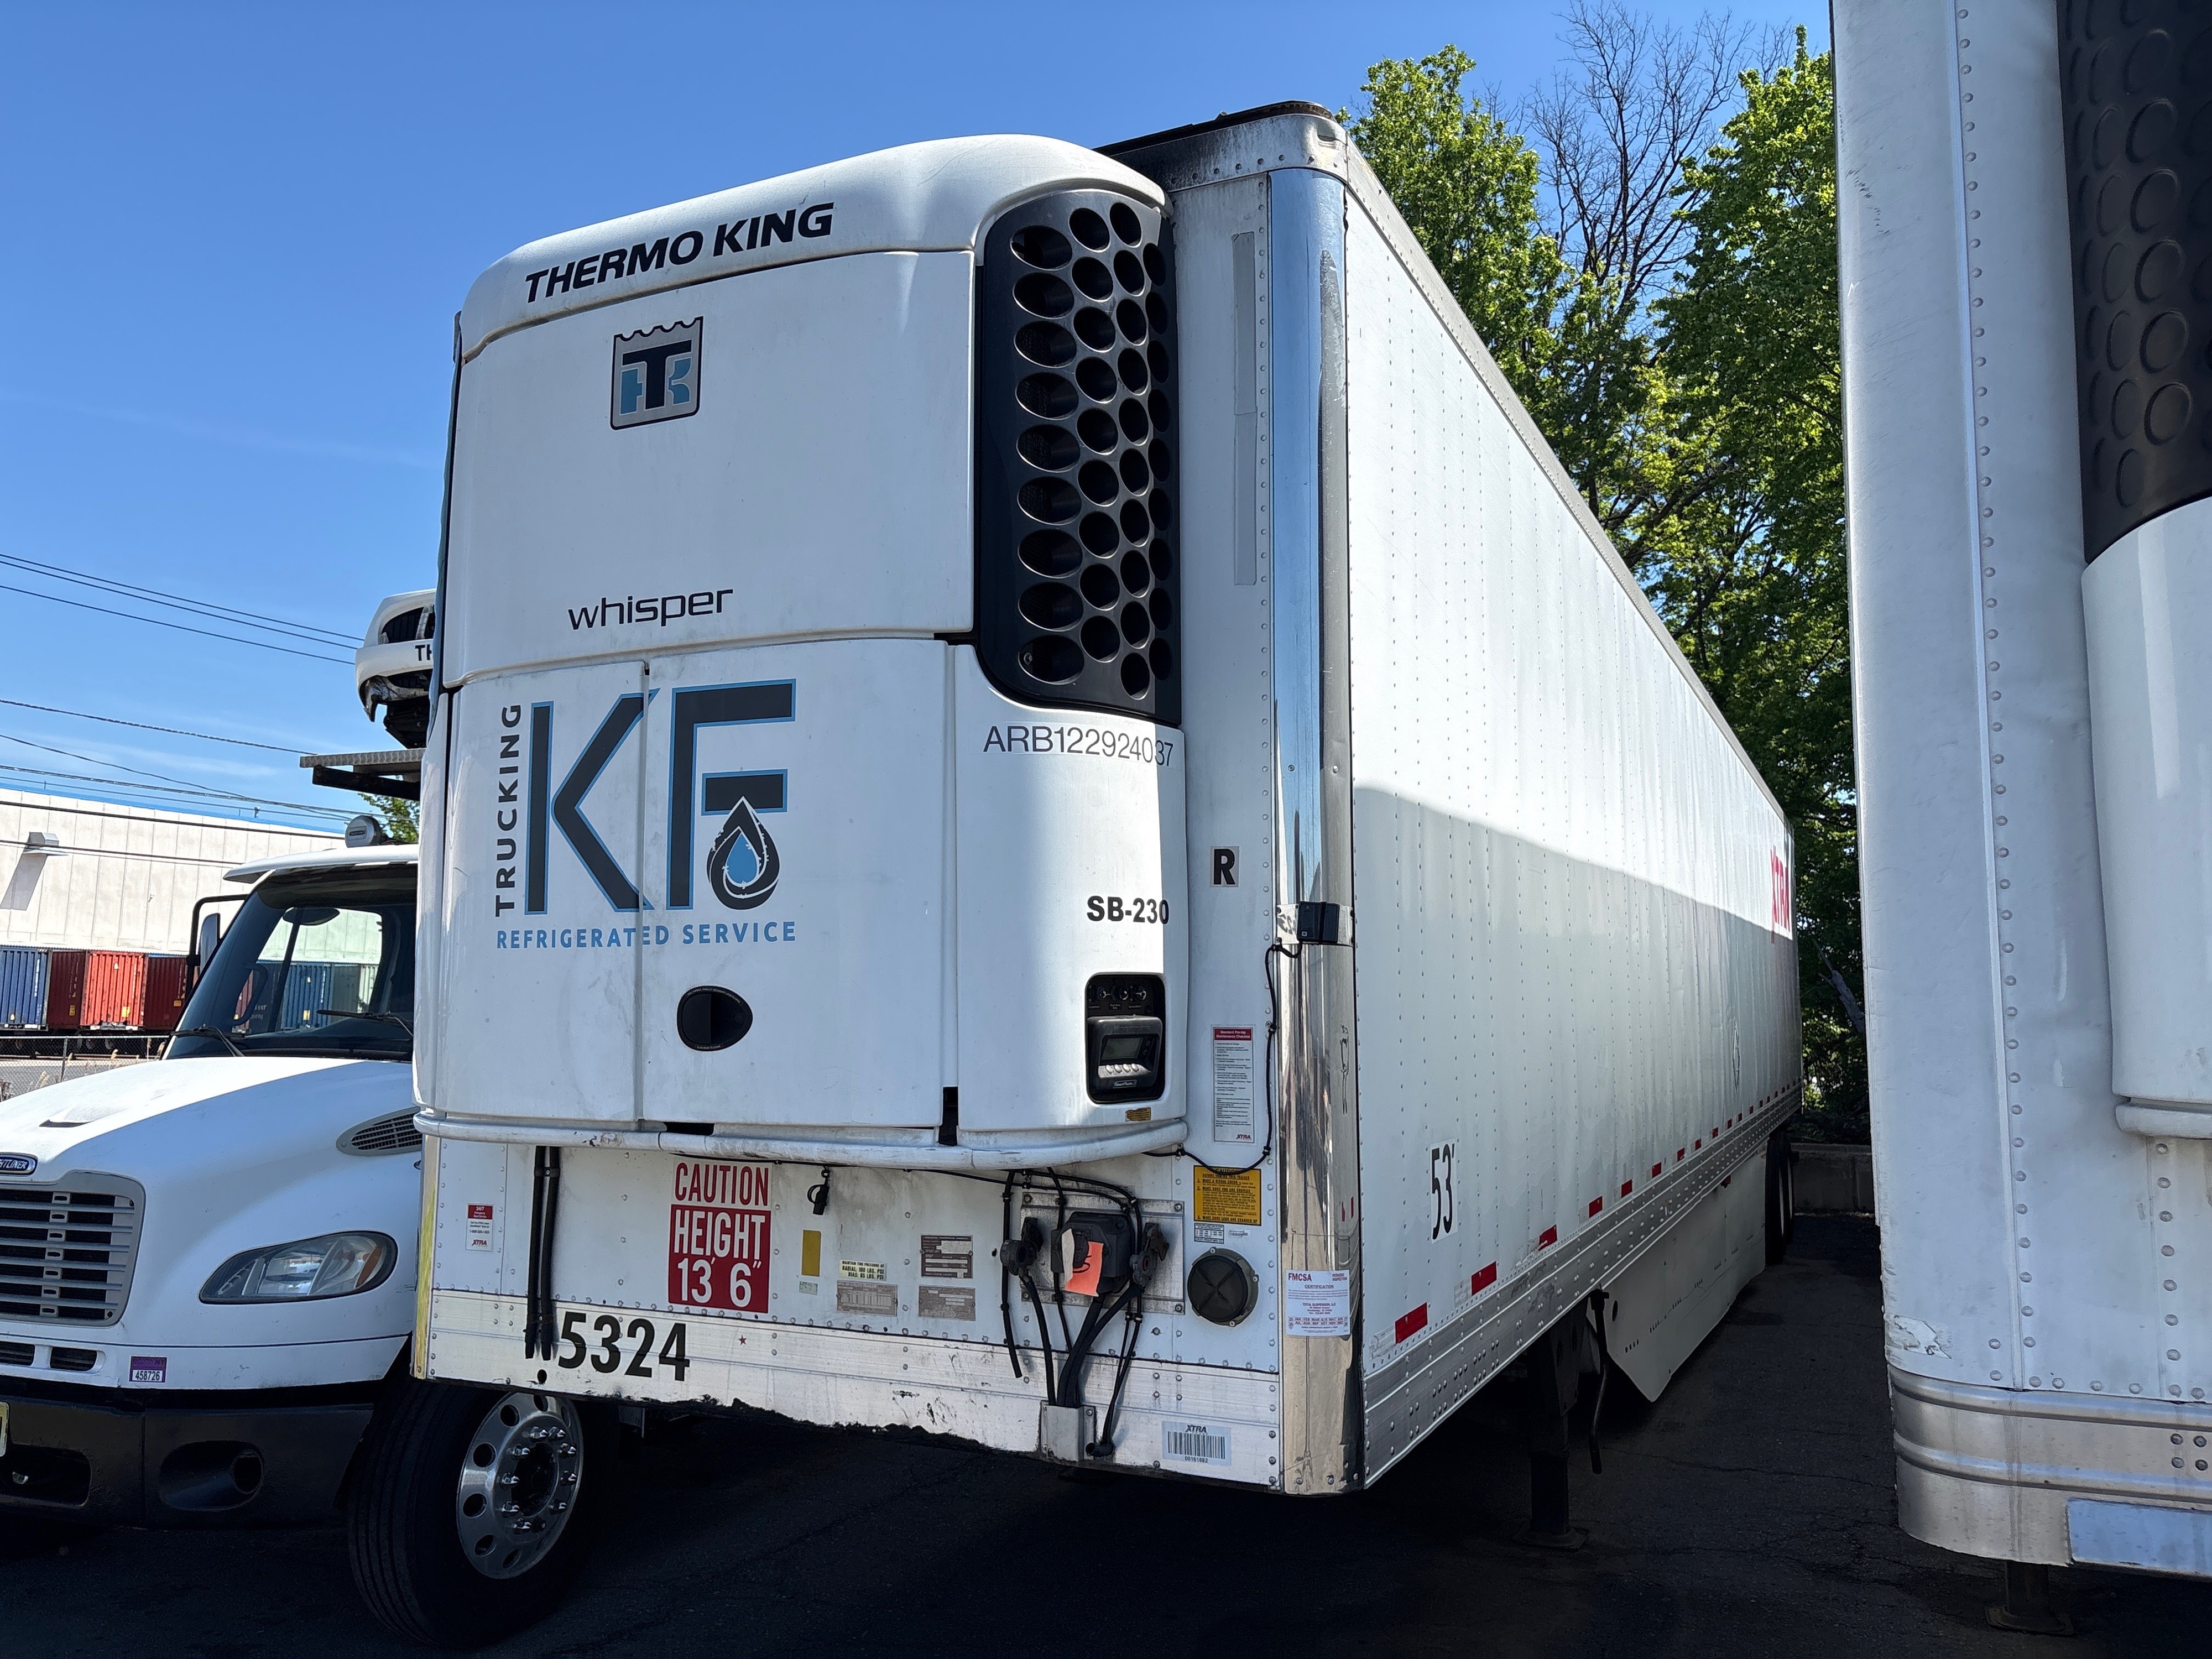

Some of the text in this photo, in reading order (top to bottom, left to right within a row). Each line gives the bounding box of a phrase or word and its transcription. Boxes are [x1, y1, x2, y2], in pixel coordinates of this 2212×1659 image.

[525, 201, 835, 303] THERMO KING
[567, 588, 733, 630] whisper
[983, 726, 1174, 767] ARB122924037
[495, 705, 521, 917] TRUCKING
[524, 678, 797, 916] KF
[1213, 848, 1236, 885] R
[1086, 895, 1169, 925] SB-230
[497, 921, 796, 950] REFRIGERATED SERVICE
[675, 1162, 769, 1206] CAUTION
[1431, 1143, 1455, 1240] 53'
[674, 1209, 766, 1260] HEIGHT
[677, 1257, 762, 1308] 13' 6"
[1288, 1272, 1312, 1281] FMCSA
[135, 1370, 160, 1381] 458726
[1185, 1424, 1207, 1433] XTRA
